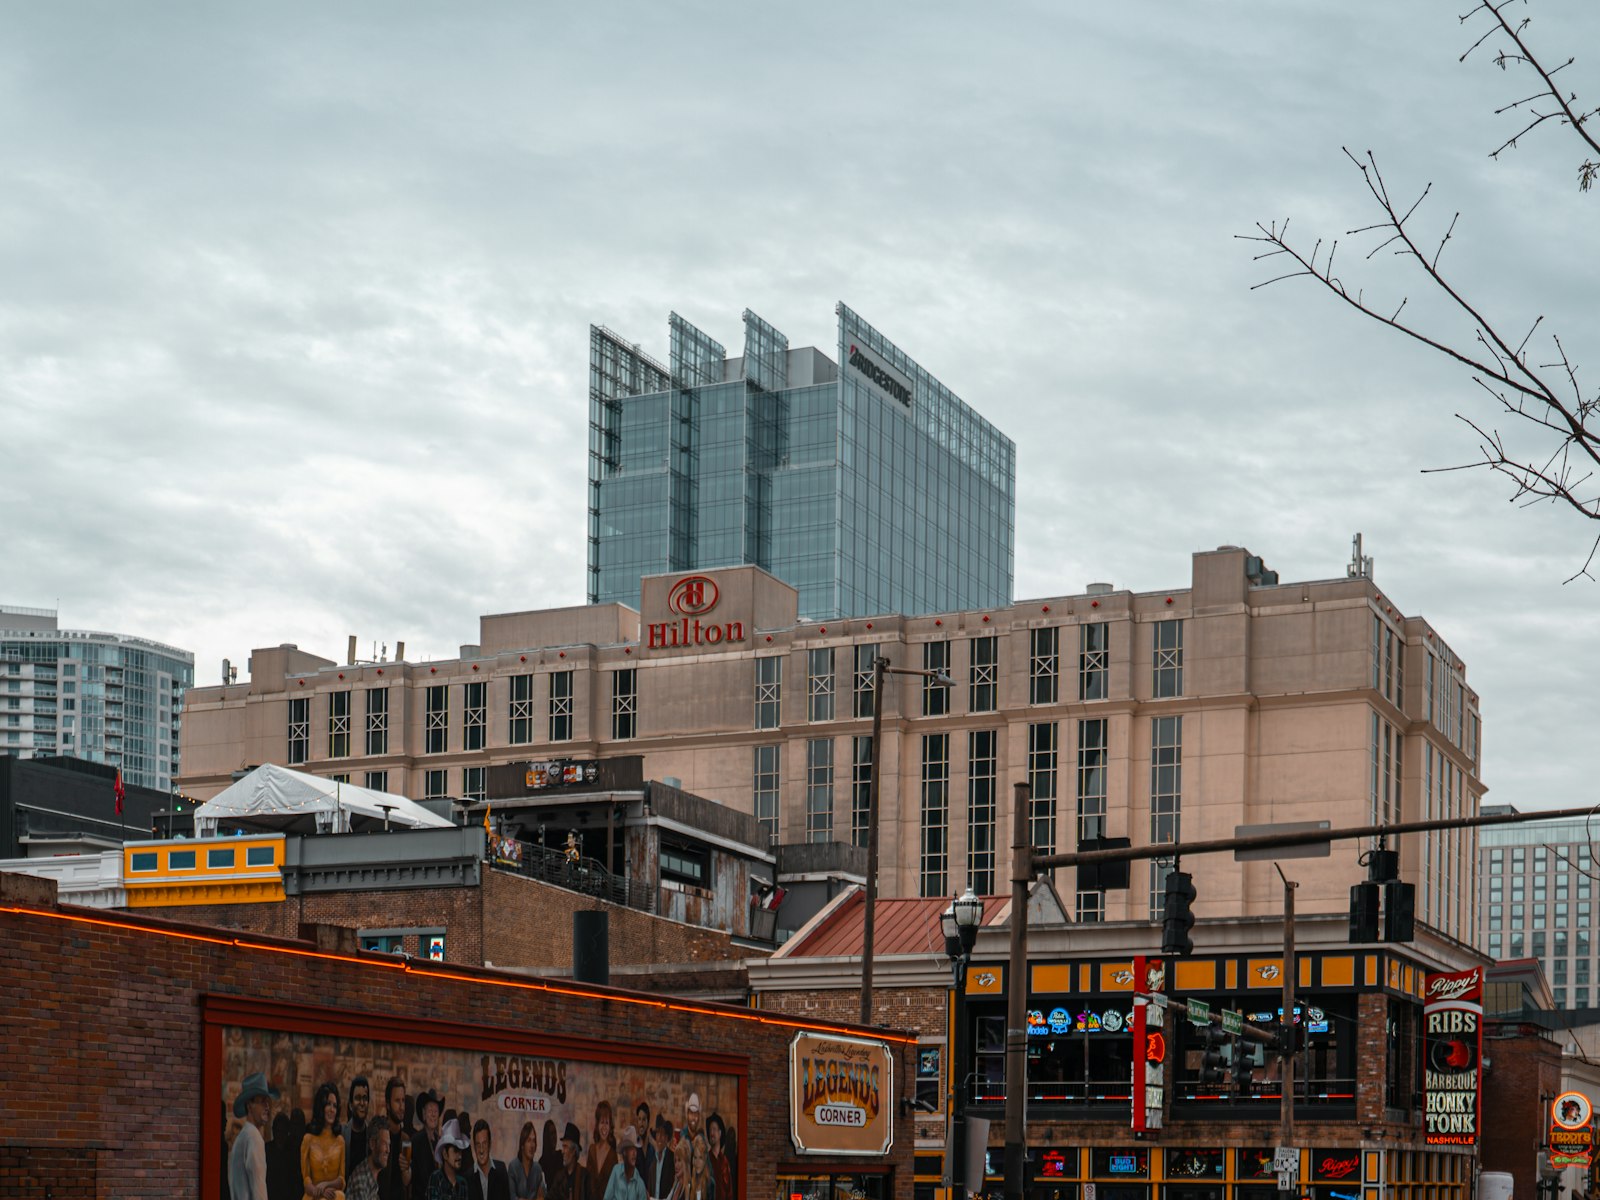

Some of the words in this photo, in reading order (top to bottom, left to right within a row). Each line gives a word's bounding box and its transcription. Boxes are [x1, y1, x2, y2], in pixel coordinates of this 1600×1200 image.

[849, 344, 912, 408] BRIDGESTONE
[647, 618, 746, 649] Hilton
[1426, 968, 1479, 996] Rippy's
[1428, 1010, 1477, 1034] RIBS
[480, 1055, 567, 1105] LEGENDS
[802, 1057, 880, 1116] LEGENDS
[1426, 1068, 1477, 1090] BARBEQUE
[504, 1096, 545, 1111] CORNER
[1426, 1092, 1476, 1113] HONKY
[820, 1108, 861, 1124] CORNER
[1426, 1113, 1475, 1133] TONK
[1427, 1136, 1475, 1145] NASHVILLE
